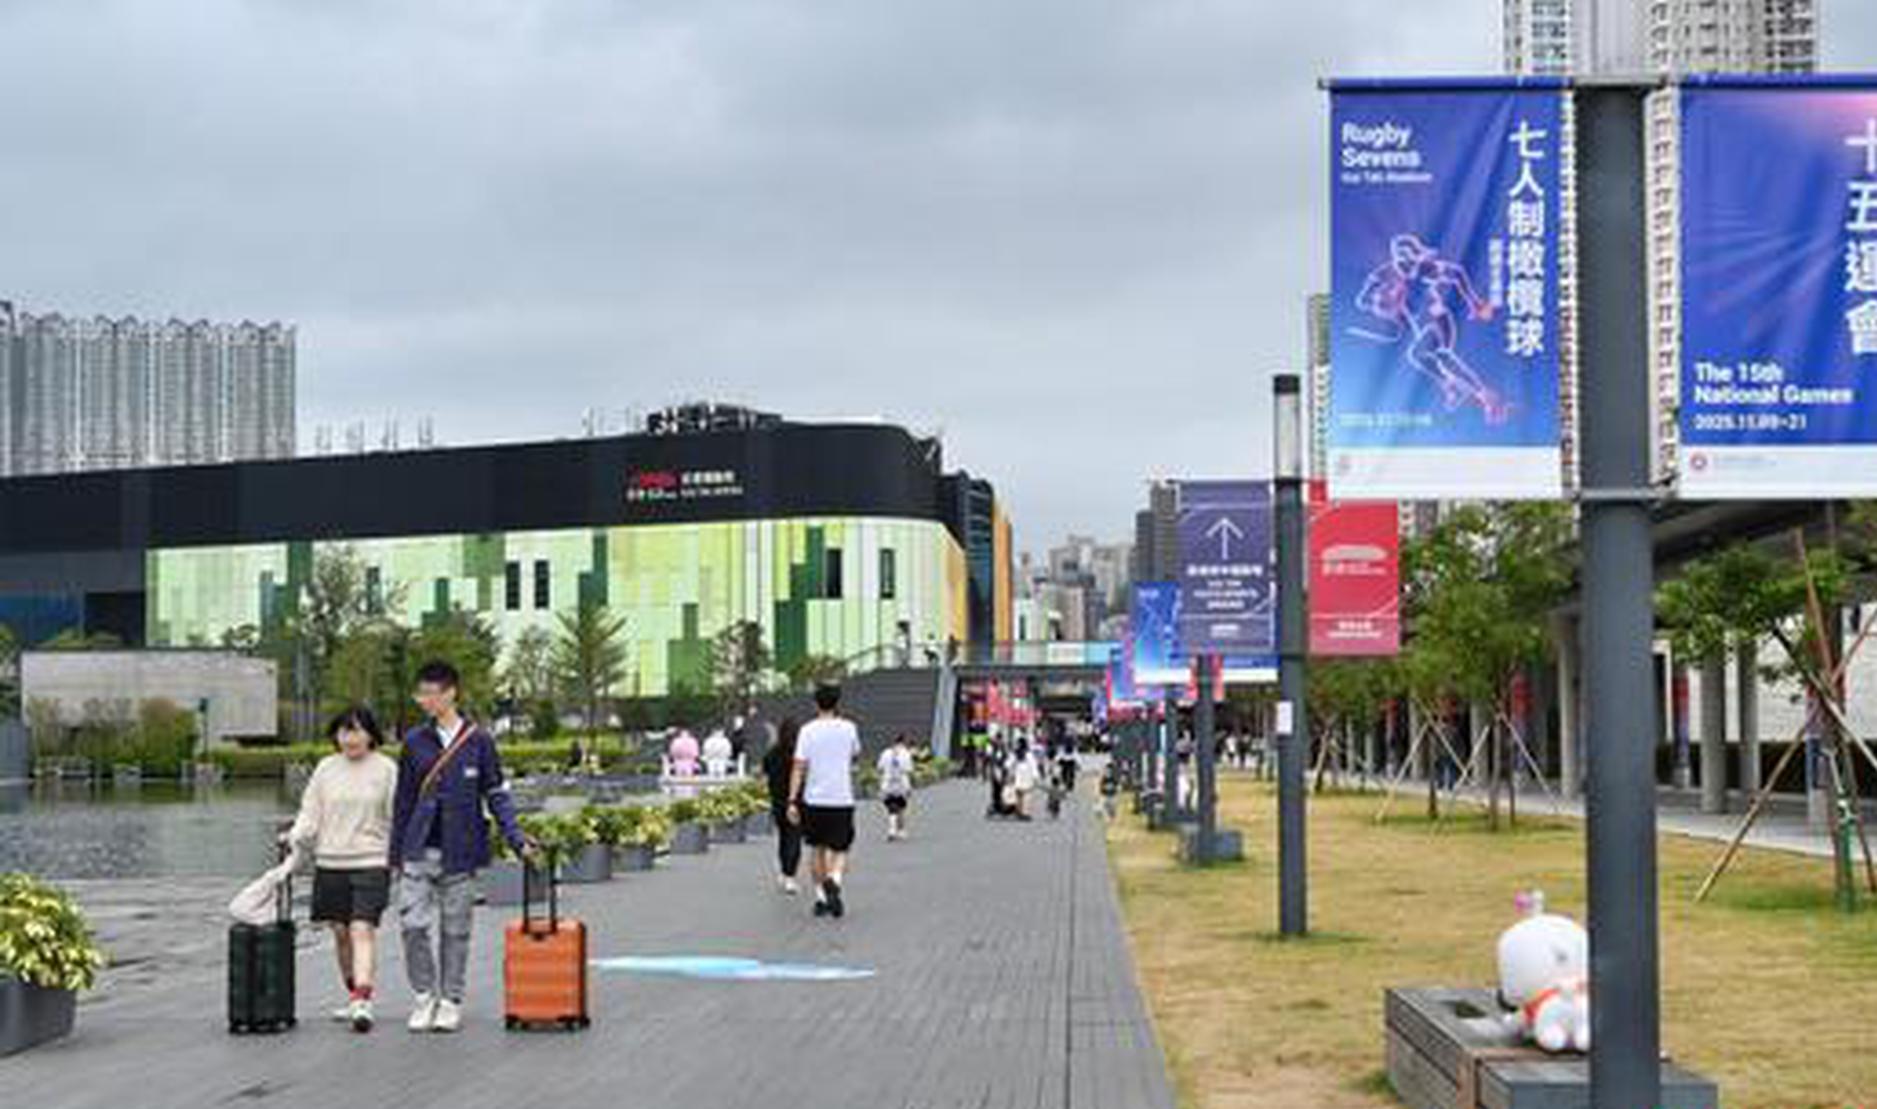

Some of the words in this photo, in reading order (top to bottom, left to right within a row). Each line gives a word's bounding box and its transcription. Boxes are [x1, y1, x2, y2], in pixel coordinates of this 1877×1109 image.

[1342, 121, 1413, 149] Rugby
[1342, 147, 1421, 168] Sevens
[1694, 361, 1733, 382] The
[1737, 361, 1784, 383] 15th
[1694, 384, 1780, 405] National
[1783, 384, 1853, 405] Games
